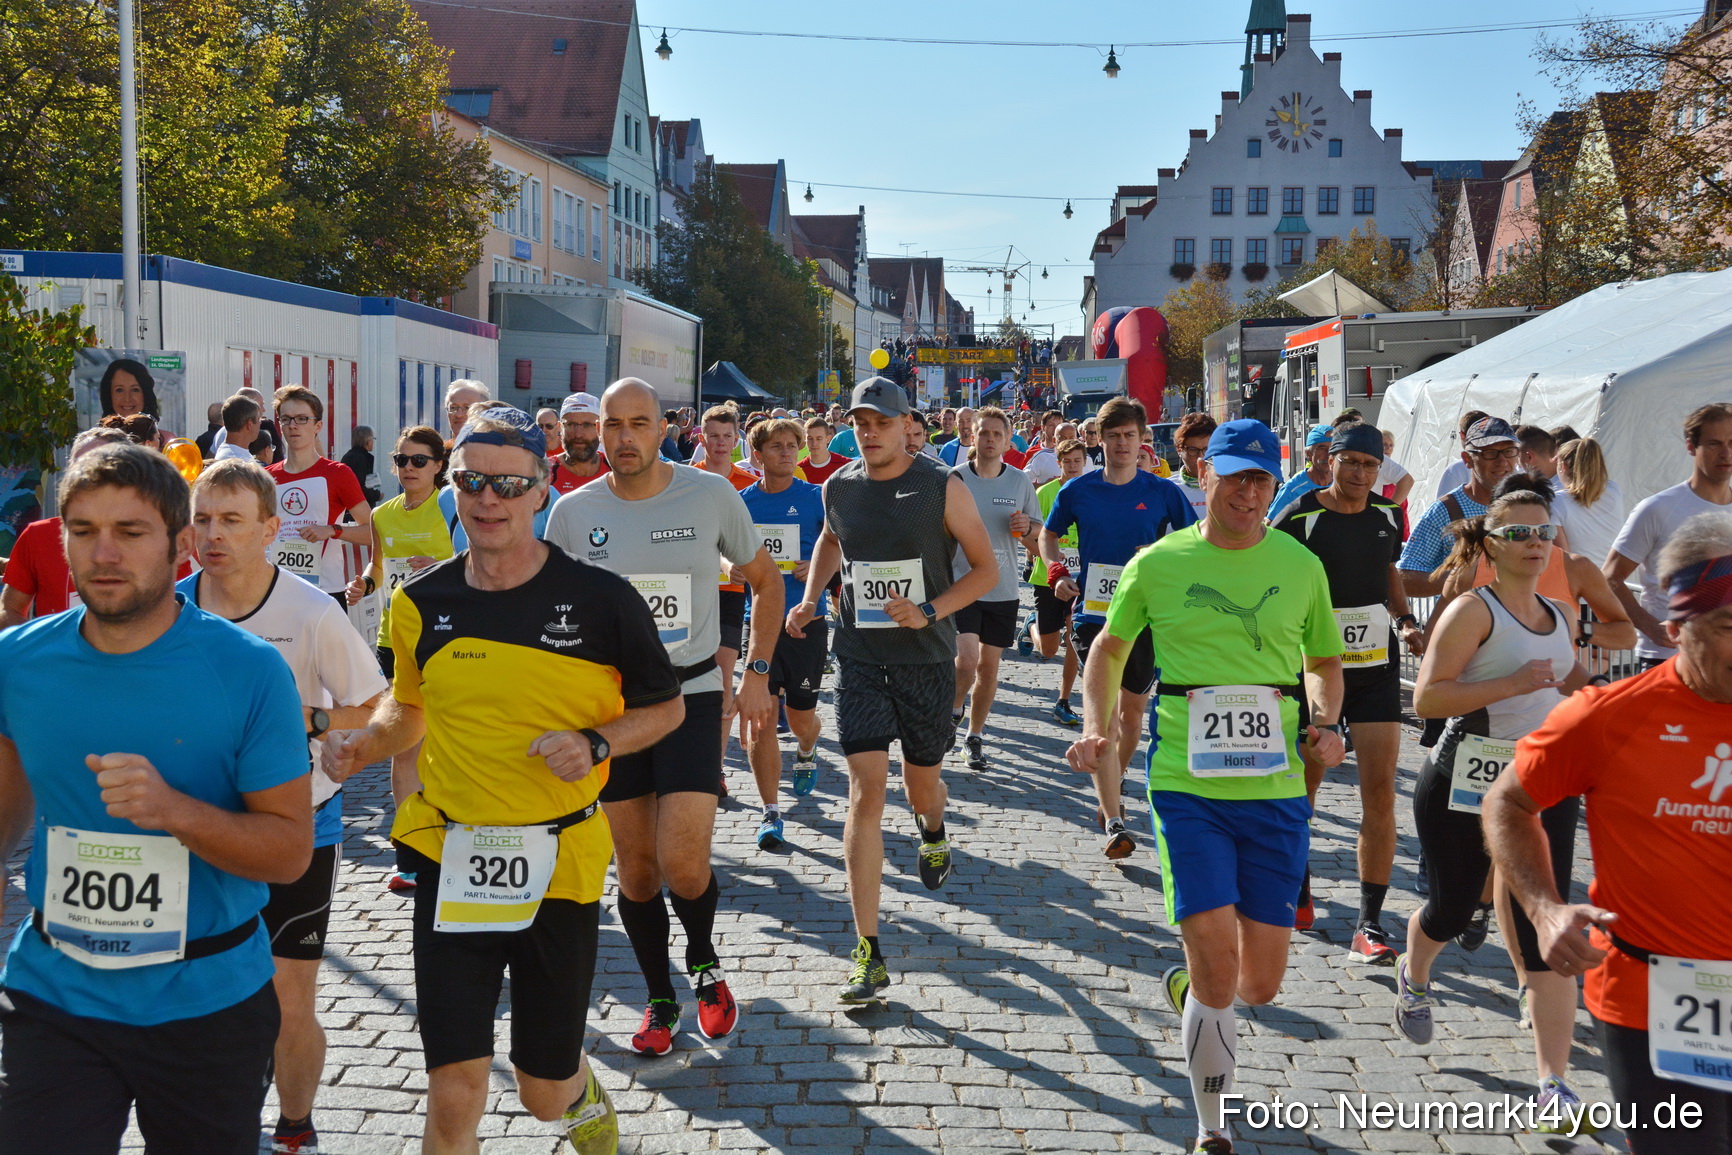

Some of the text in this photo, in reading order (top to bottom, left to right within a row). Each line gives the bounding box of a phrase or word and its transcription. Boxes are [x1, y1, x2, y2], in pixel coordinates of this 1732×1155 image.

[948, 351, 983, 359] START
[651, 527, 696, 540] BOCK
[764, 538, 782, 553] 69
[277, 552, 314, 568] 2602
[1061, 556, 1080, 568] 260
[871, 567, 901, 575] BOCK
[863, 579, 913, 600] 3007
[555, 604, 573, 612] TSV
[1341, 612, 1371, 621] BOCK
[1344, 625, 1368, 643] 67
[540, 634, 583, 648] Burgthann
[452, 650, 487, 660] Markus
[1340, 653, 1373, 662] Matthias
[1215, 694, 1258, 704] BOCK
[1203, 711, 1270, 740] 2138
[1224, 754, 1256, 767] Horst
[1471, 783, 1489, 791] PARTL
[1653, 797, 1732, 819] funrun
[474, 834, 523, 847] BOCK
[78, 842, 142, 860] BOCK
[469, 855, 529, 888] 320
[62, 866, 163, 912] 2604
[464, 891, 522, 900] PARTL Neumarkt
[68, 913, 140, 927] PARTL Neumarkt
[300, 937, 320, 945] adidas
[1674, 993, 1732, 1037] 21
[1684, 1039, 1715, 1051] PARTL
